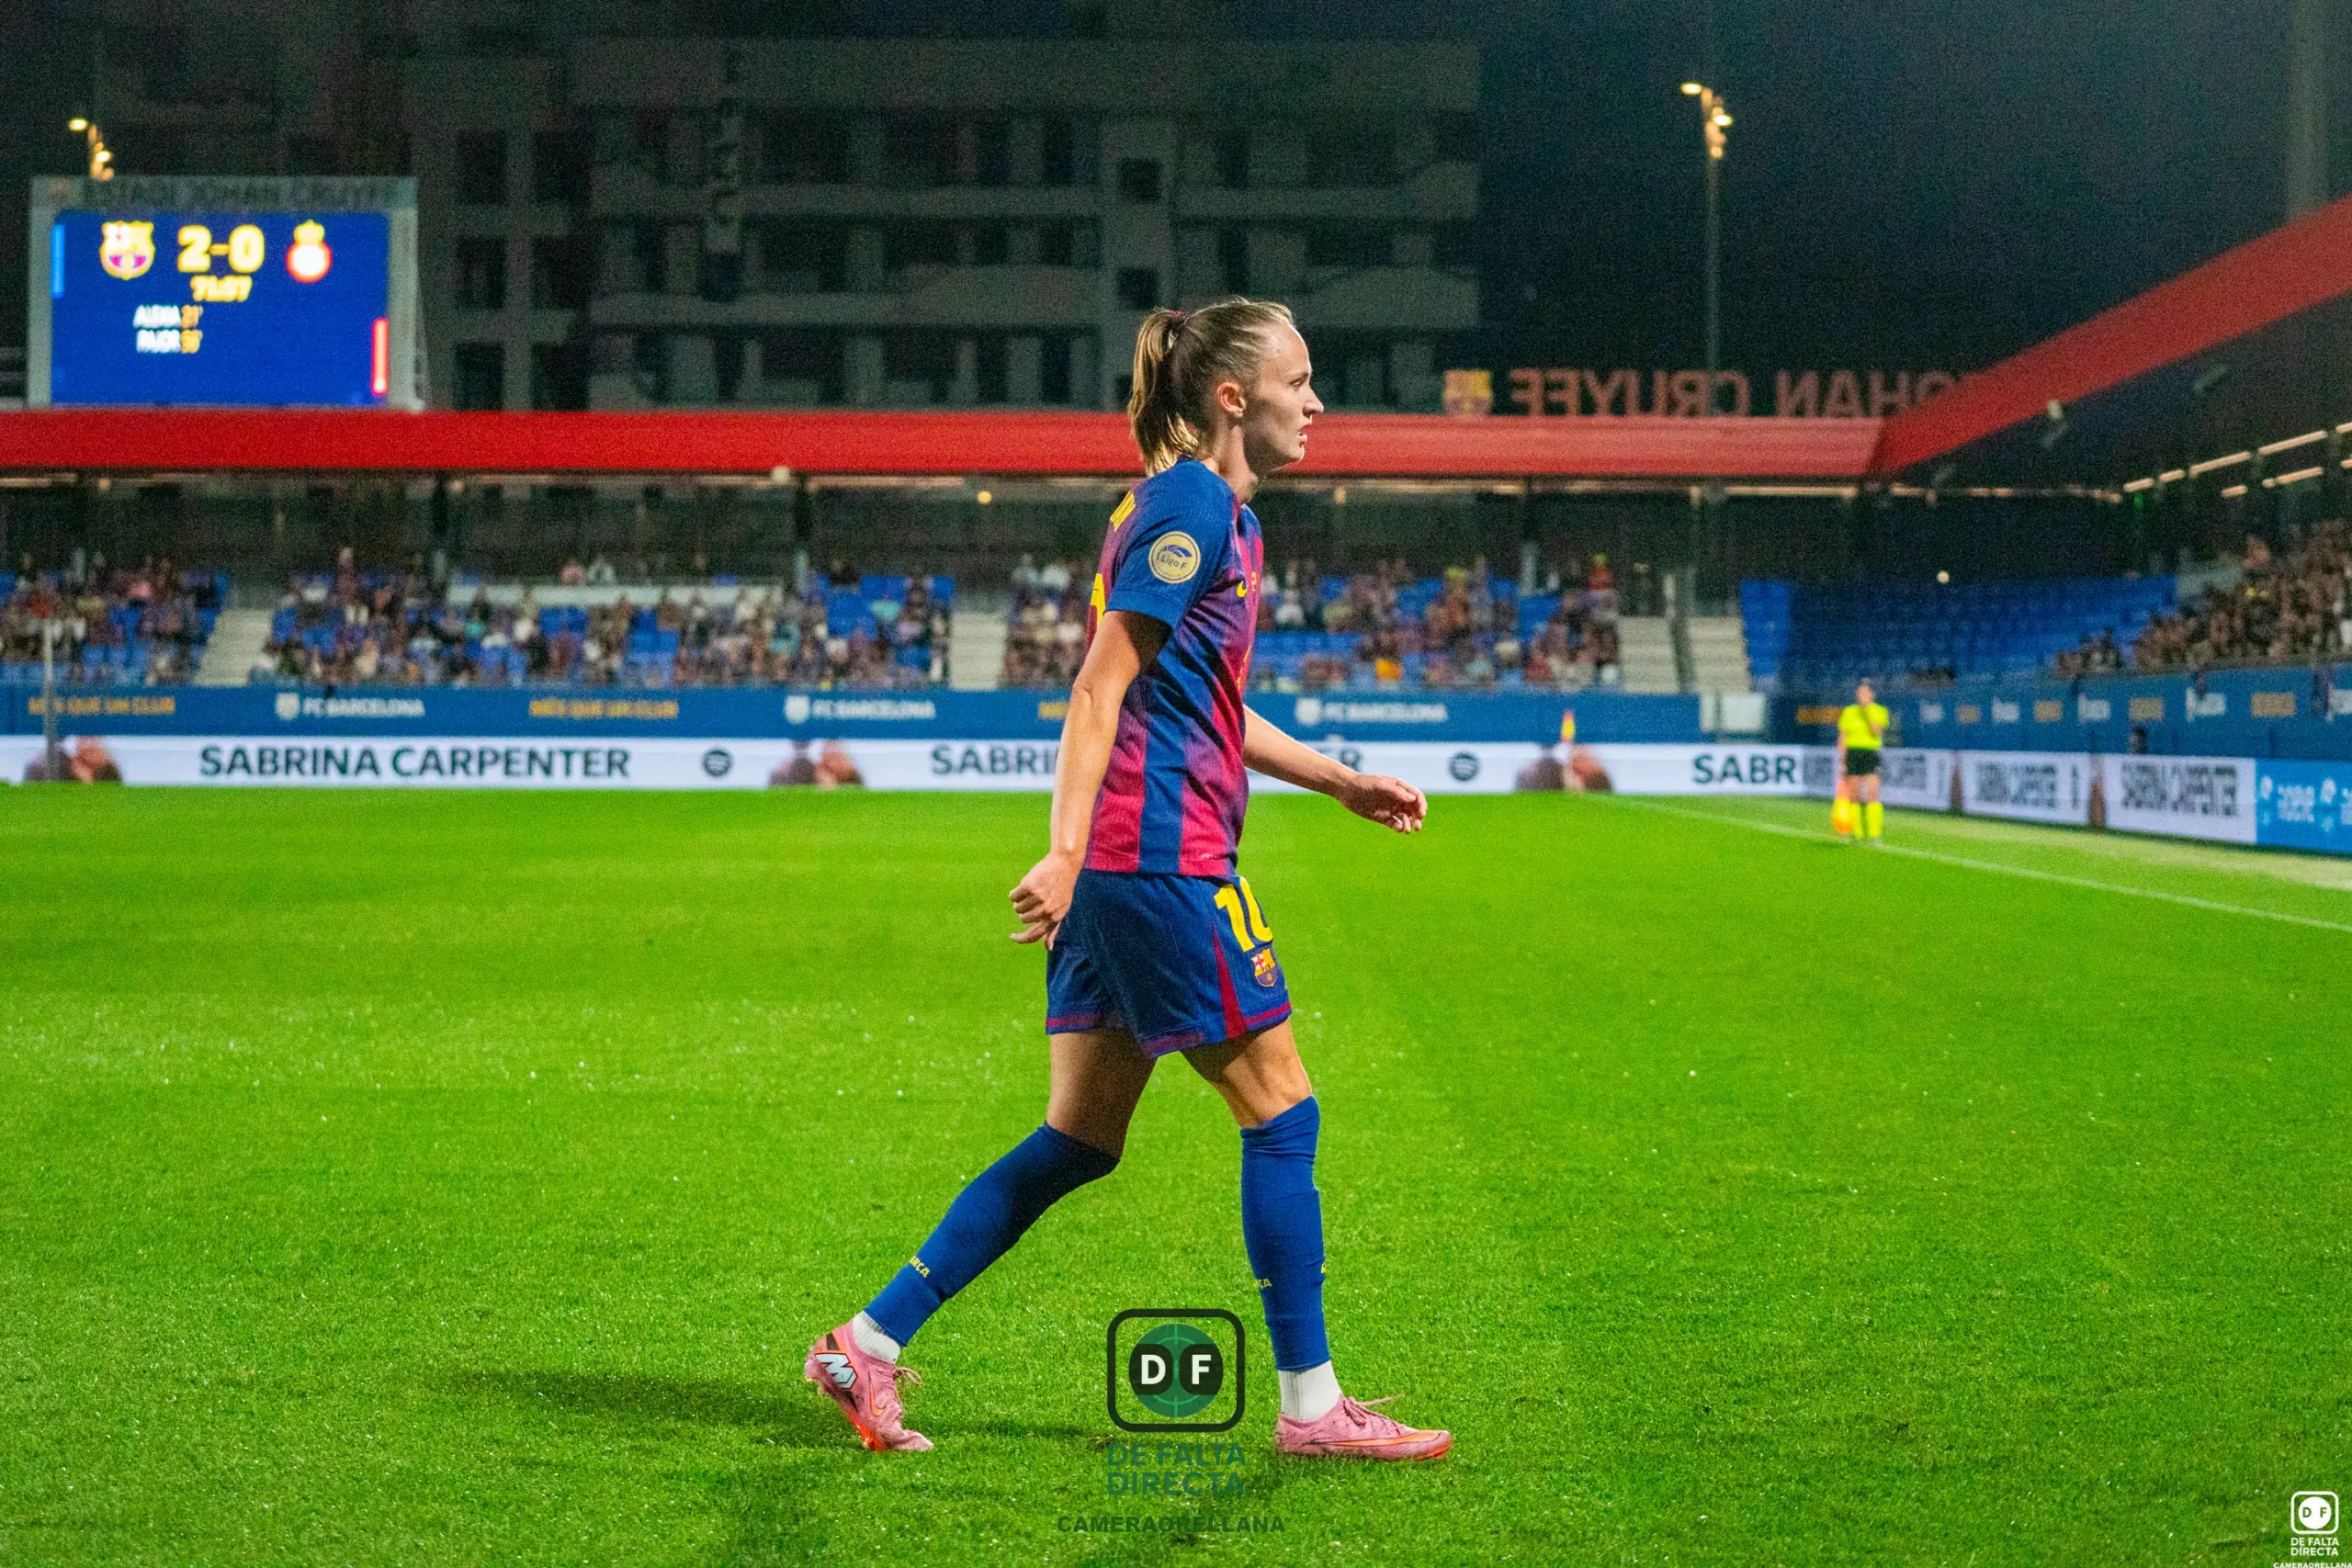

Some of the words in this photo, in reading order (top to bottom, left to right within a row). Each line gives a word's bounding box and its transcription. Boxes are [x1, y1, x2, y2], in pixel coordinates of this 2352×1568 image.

[178, 225, 265, 273] 2-0
[200, 745, 380, 776] SABRINA
[391, 746, 631, 777] CARPENTER
[932, 745, 1057, 775] SABRI
